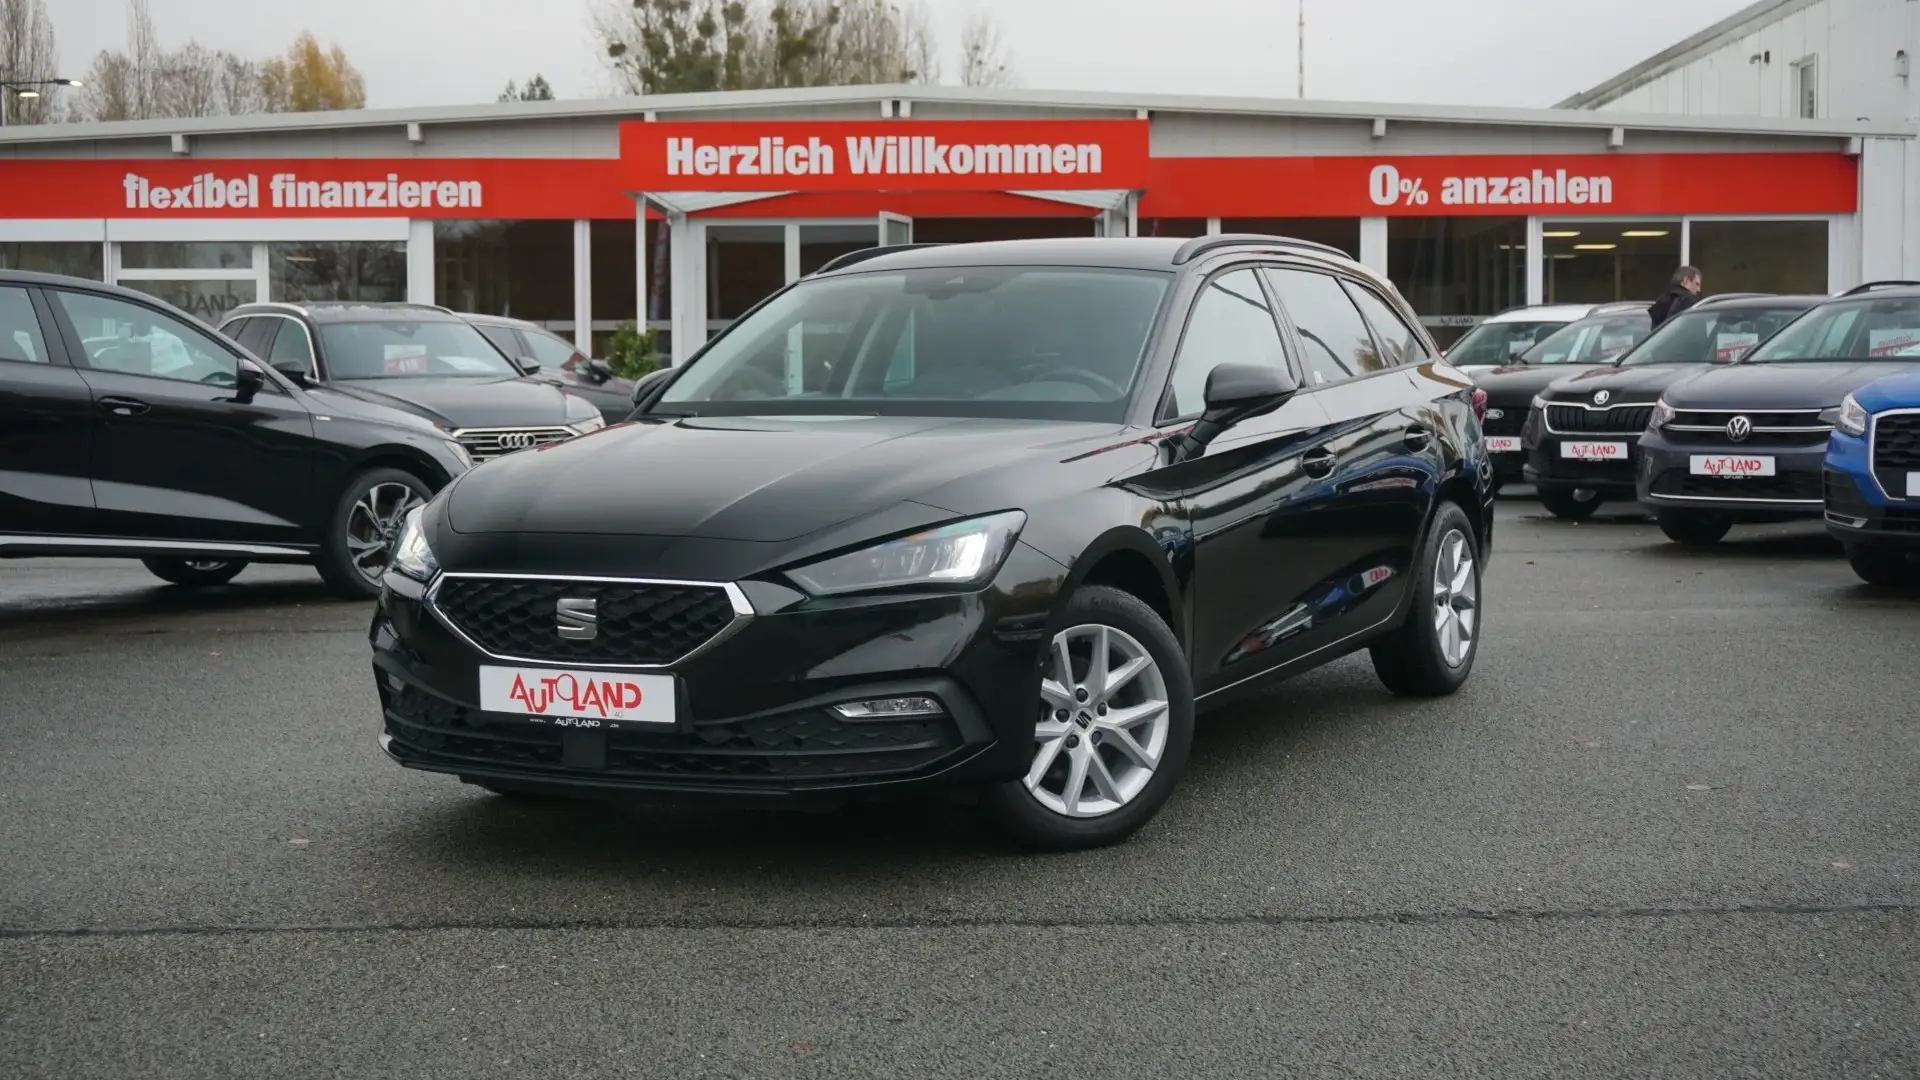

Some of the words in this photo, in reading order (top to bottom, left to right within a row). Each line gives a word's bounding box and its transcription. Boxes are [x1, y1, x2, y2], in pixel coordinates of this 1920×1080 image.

[666, 136, 834, 176] Herzlich
[845, 135, 1102, 175] Willkommen
[123, 172, 259, 209] flexibel
[269, 173, 482, 209] finanzieren
[1369, 164, 1429, 206] 0%
[1440, 169, 1612, 205] anzahlen
[1703, 457, 1762, 475] AUTOLAND
[509, 672, 642, 717] AUTOLAND
[554, 717, 601, 728] AUTOLAND
